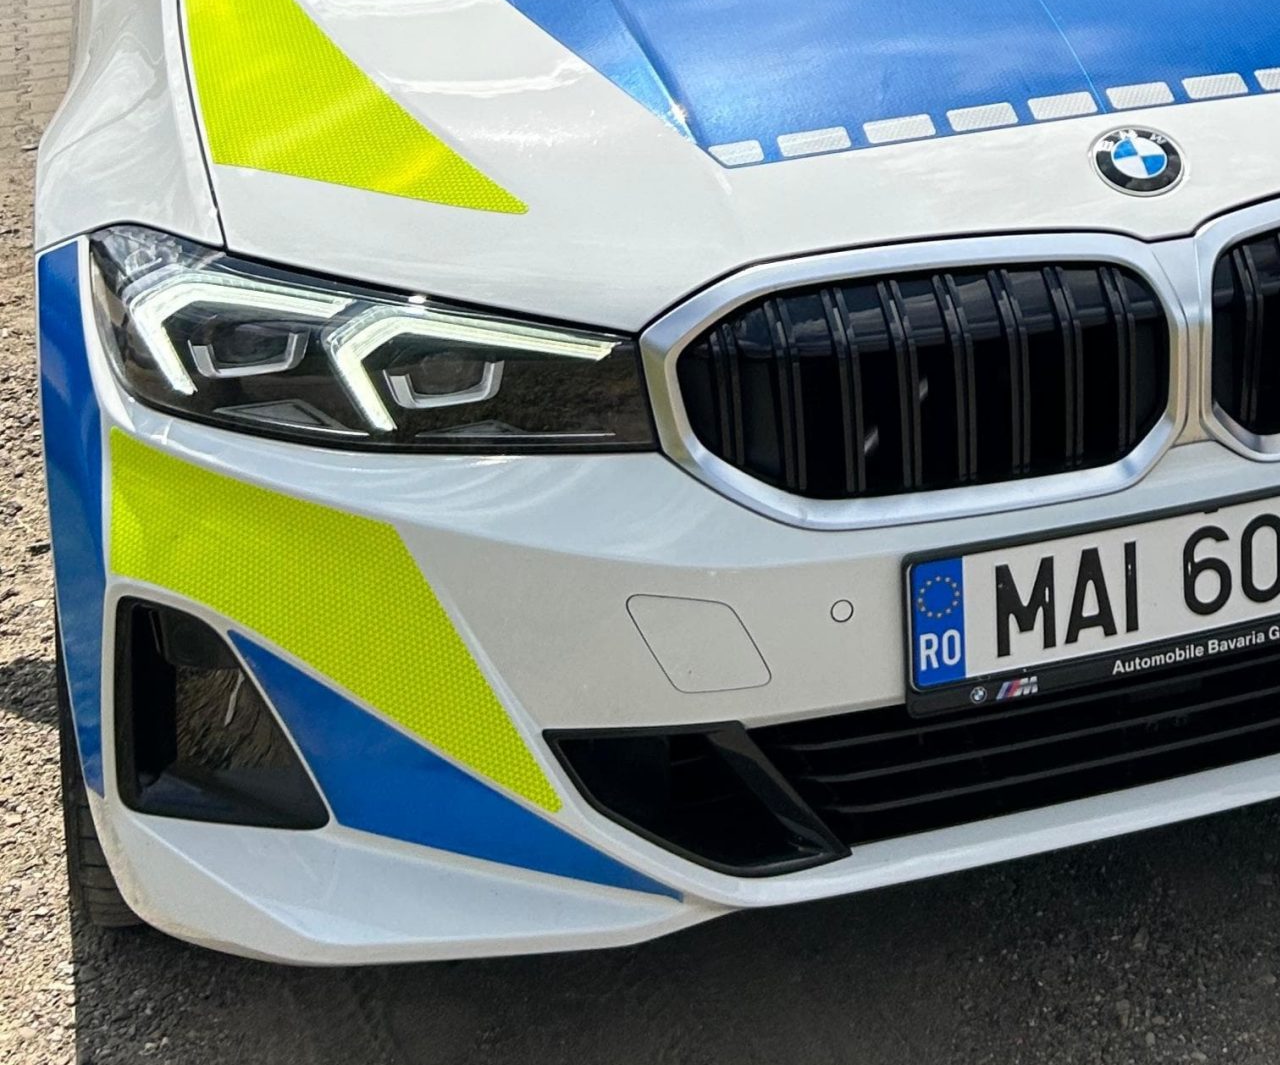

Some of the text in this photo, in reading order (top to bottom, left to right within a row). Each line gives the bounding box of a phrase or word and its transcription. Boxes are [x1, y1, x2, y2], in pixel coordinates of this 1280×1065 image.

[995, 540, 1139, 658] MAI
[919, 629, 962, 672] RO
[1112, 644, 1204, 675] Automobile
[1208, 630, 1265, 655] Bavaria
